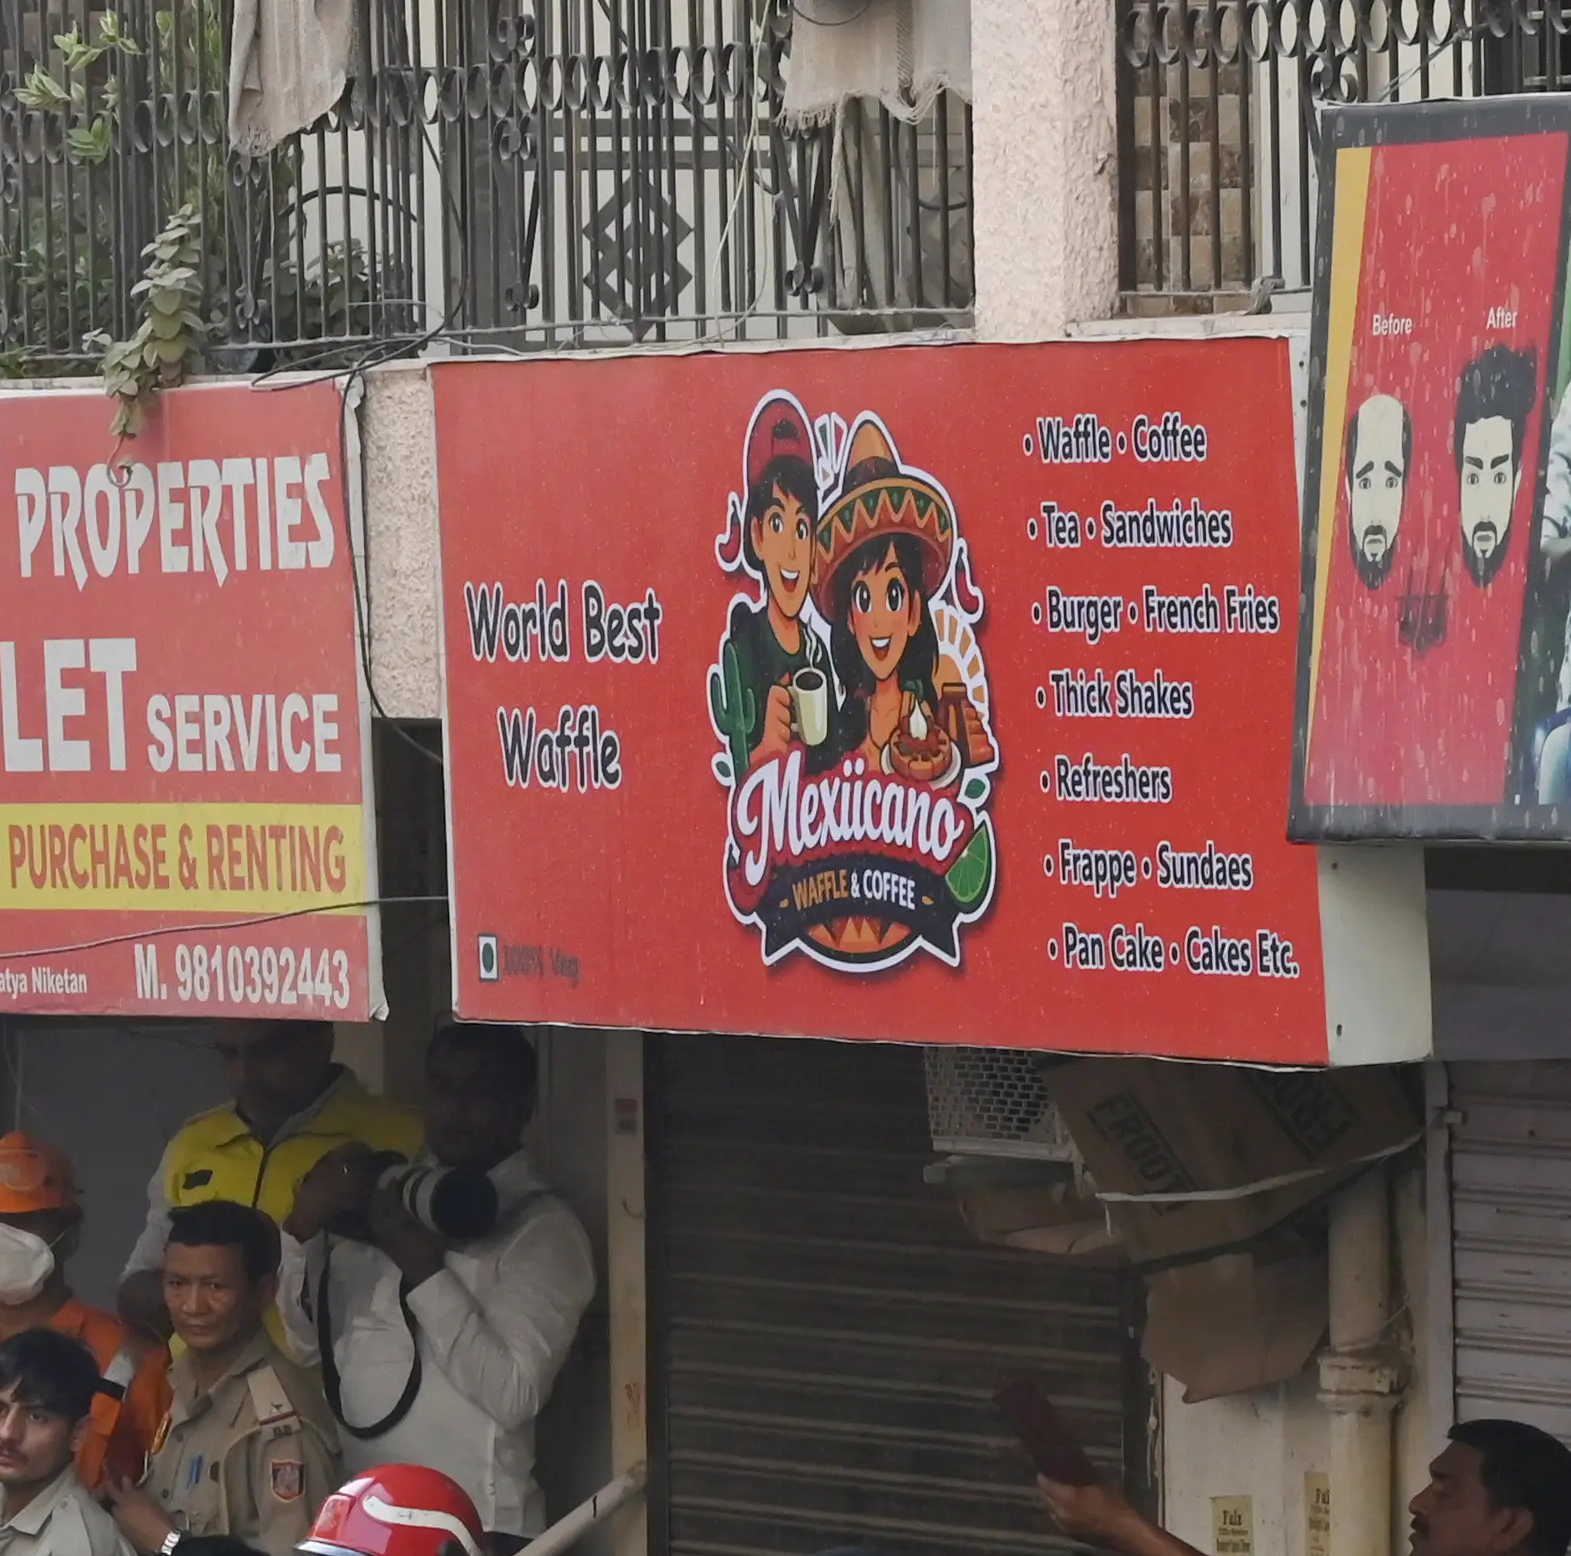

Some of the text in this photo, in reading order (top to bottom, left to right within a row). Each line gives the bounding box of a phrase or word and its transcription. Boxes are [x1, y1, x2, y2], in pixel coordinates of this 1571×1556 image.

[1372, 313, 1412, 335] Before
[1486, 307, 1517, 329] After
[1037, 412, 1206, 463] Waffle Coffee
[15, 453, 335, 591] PROPERTIES
[1041, 498, 1233, 547] Tea Sandwiches
[464, 578, 662, 664] World Best
[1047, 584, 1279, 644] Burger French Fries
[1050, 668, 1194, 718] Thick Shakes
[147, 693, 341, 773] SERVICE
[498, 704, 622, 793] Waffle
[1055, 752, 1172, 802] Refreshers
[9, 824, 170, 889] PURCHASE
[178, 823, 199, 890] &
[207, 825, 346, 893] RENTING
[1059, 838, 1253, 898] Frappe Sundaes
[792, 869, 916, 910] WAFFLE & COFFEE
[135, 944, 349, 1008] M. 9810392443
[1063, 922, 1299, 977] Pan Cake Cakes Etc.
[32, 968, 87, 995] Niketan
